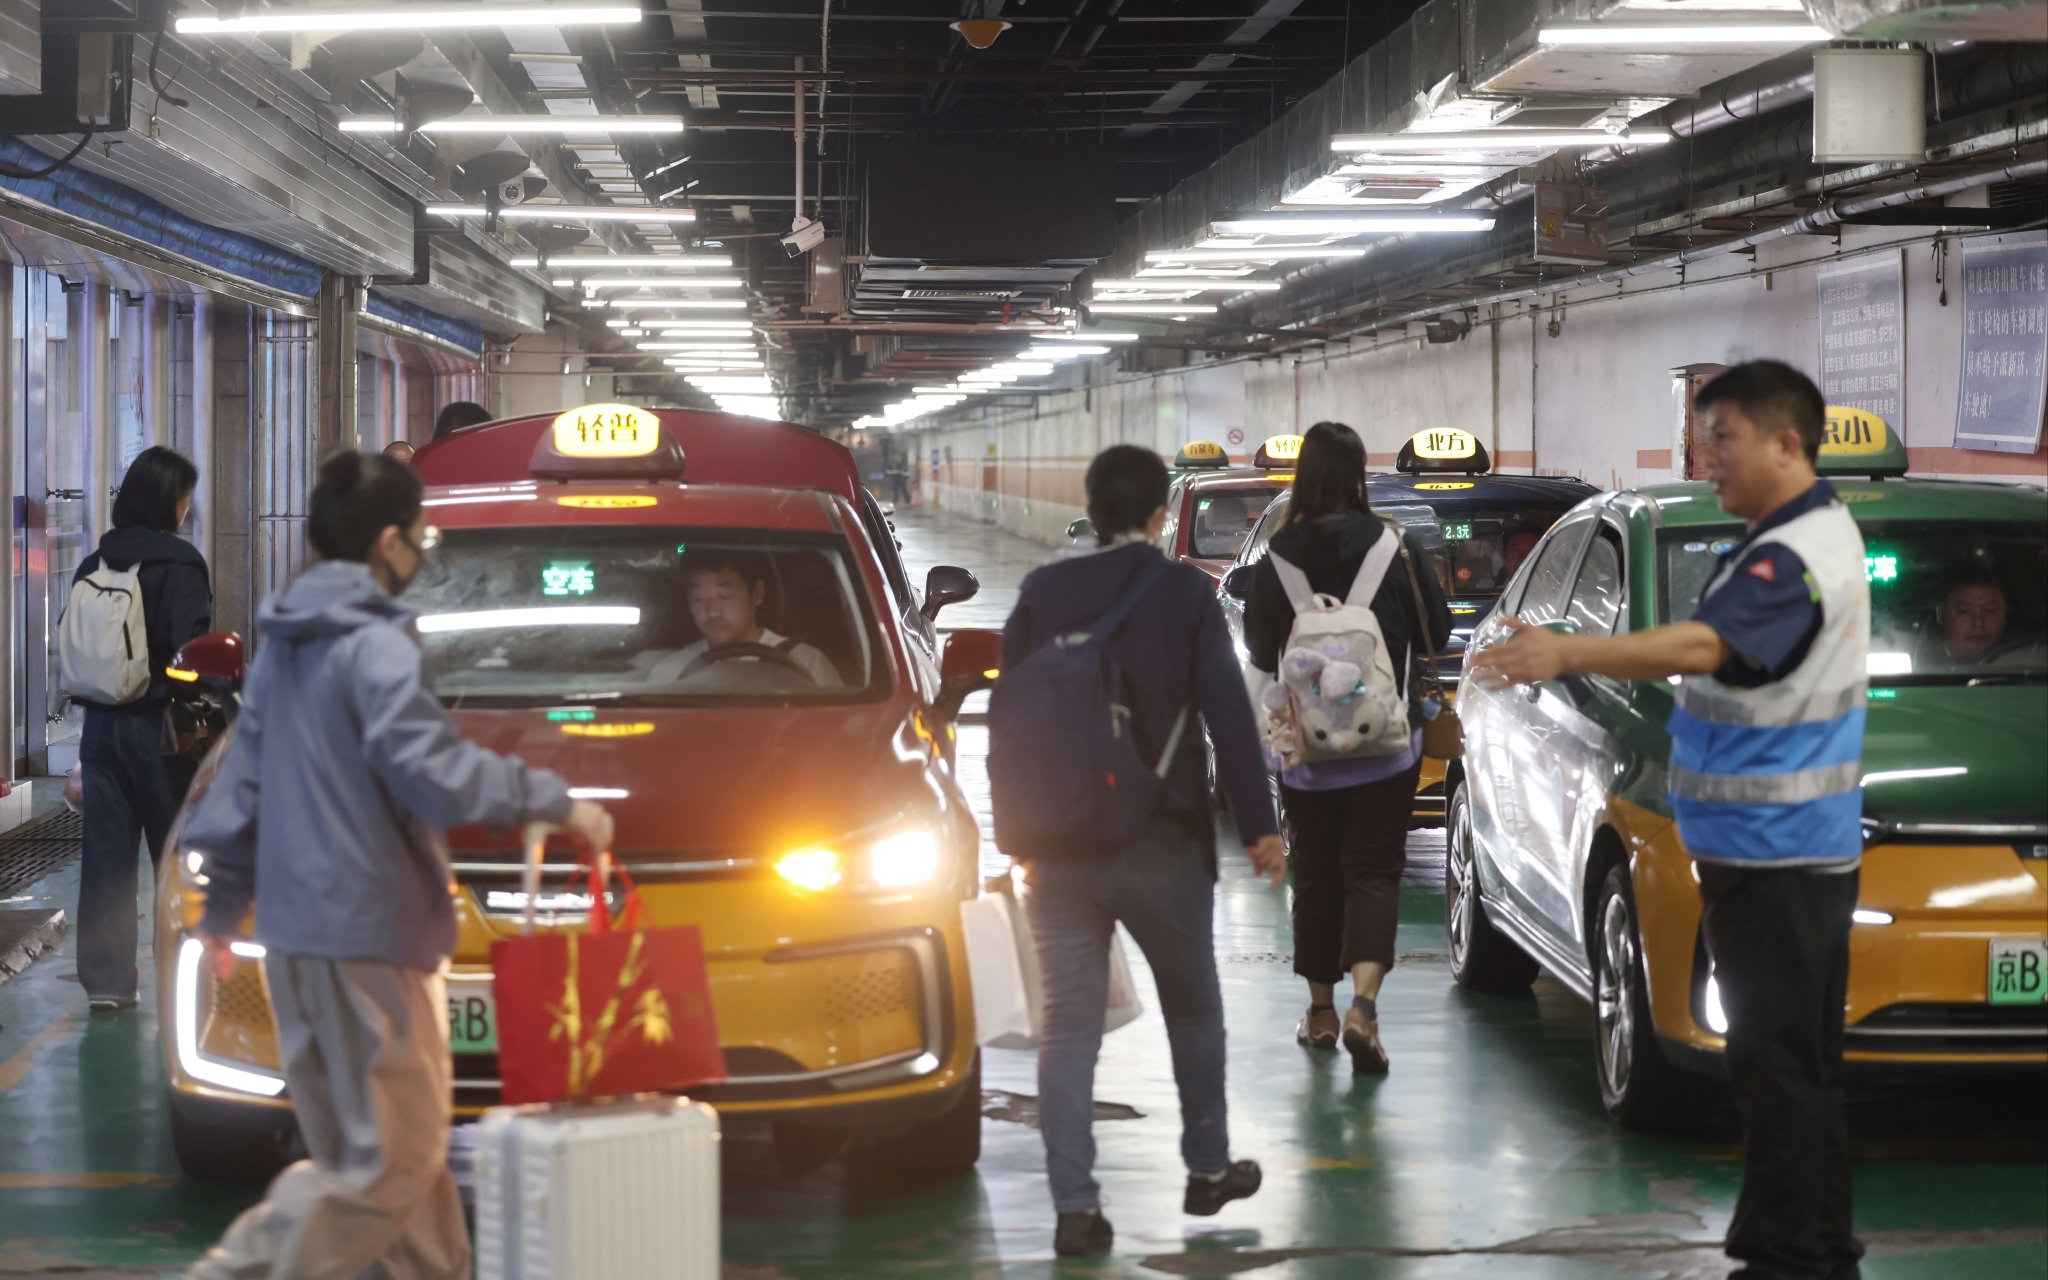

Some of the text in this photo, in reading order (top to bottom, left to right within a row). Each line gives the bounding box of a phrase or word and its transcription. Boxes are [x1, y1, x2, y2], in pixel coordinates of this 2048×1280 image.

[577, 413, 637, 442] 轻普
[1425, 432, 1464, 451] 北方
[1445, 525, 1470, 539] 2.3元
[543, 566, 594, 595] 空车
[1996, 950, 2041, 993] 京B
